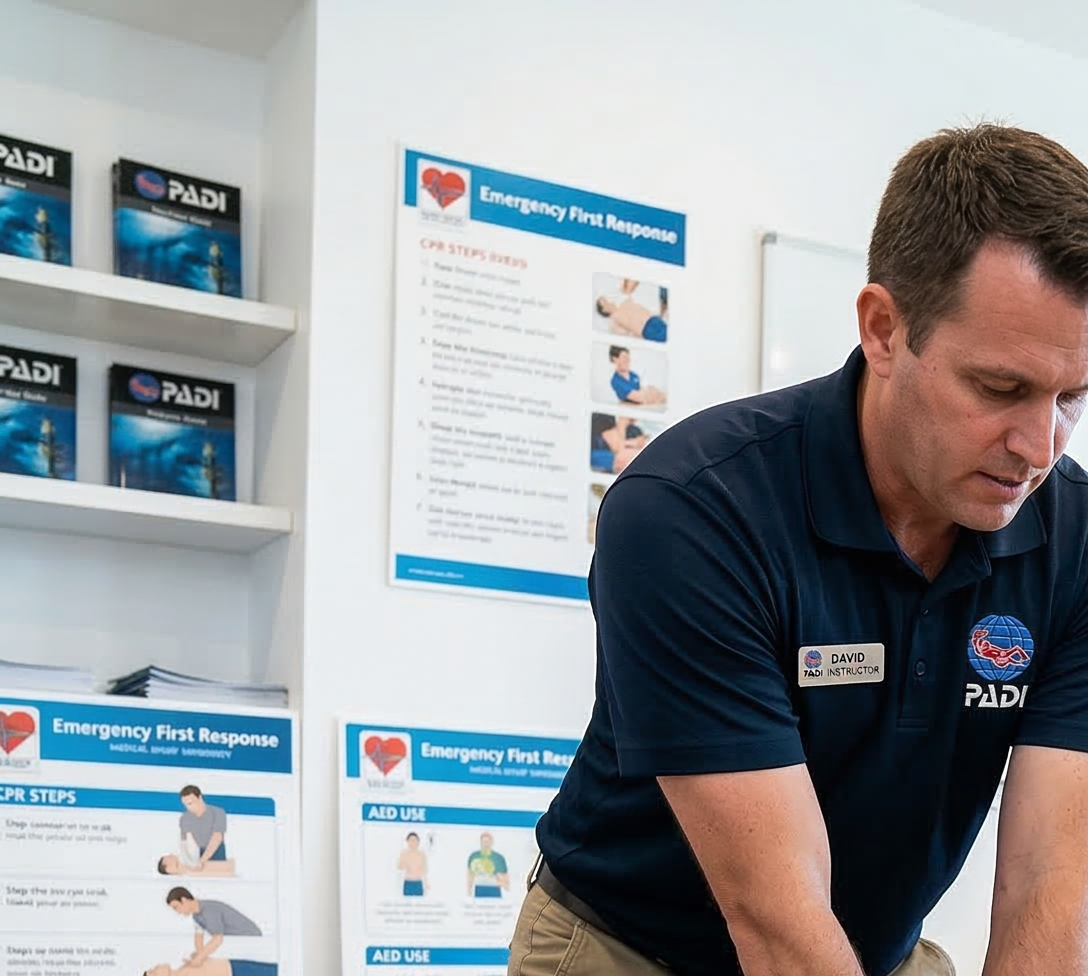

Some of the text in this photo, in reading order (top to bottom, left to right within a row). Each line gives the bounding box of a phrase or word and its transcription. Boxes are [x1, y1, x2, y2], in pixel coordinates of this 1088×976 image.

[168, 179, 227, 213] PADI
[479, 185, 567, 222] Emergency
[569, 205, 604, 227] First
[605, 213, 678, 244] Response
[0, 355, 60, 385] PADI
[162, 380, 220, 410] PADI
[831, 652, 865, 664] DAVID
[827, 665, 880, 677] INSTRUCTOR
[964, 683, 1029, 709] PADI
[52, 718, 279, 748] Emergency First Response
[421, 742, 505, 766] Emergency
[507, 747, 540, 765] First
[29, 788, 77, 805] STEPS
[368, 805, 427, 821] AED USE
[372, 949, 430, 963] AED USE
